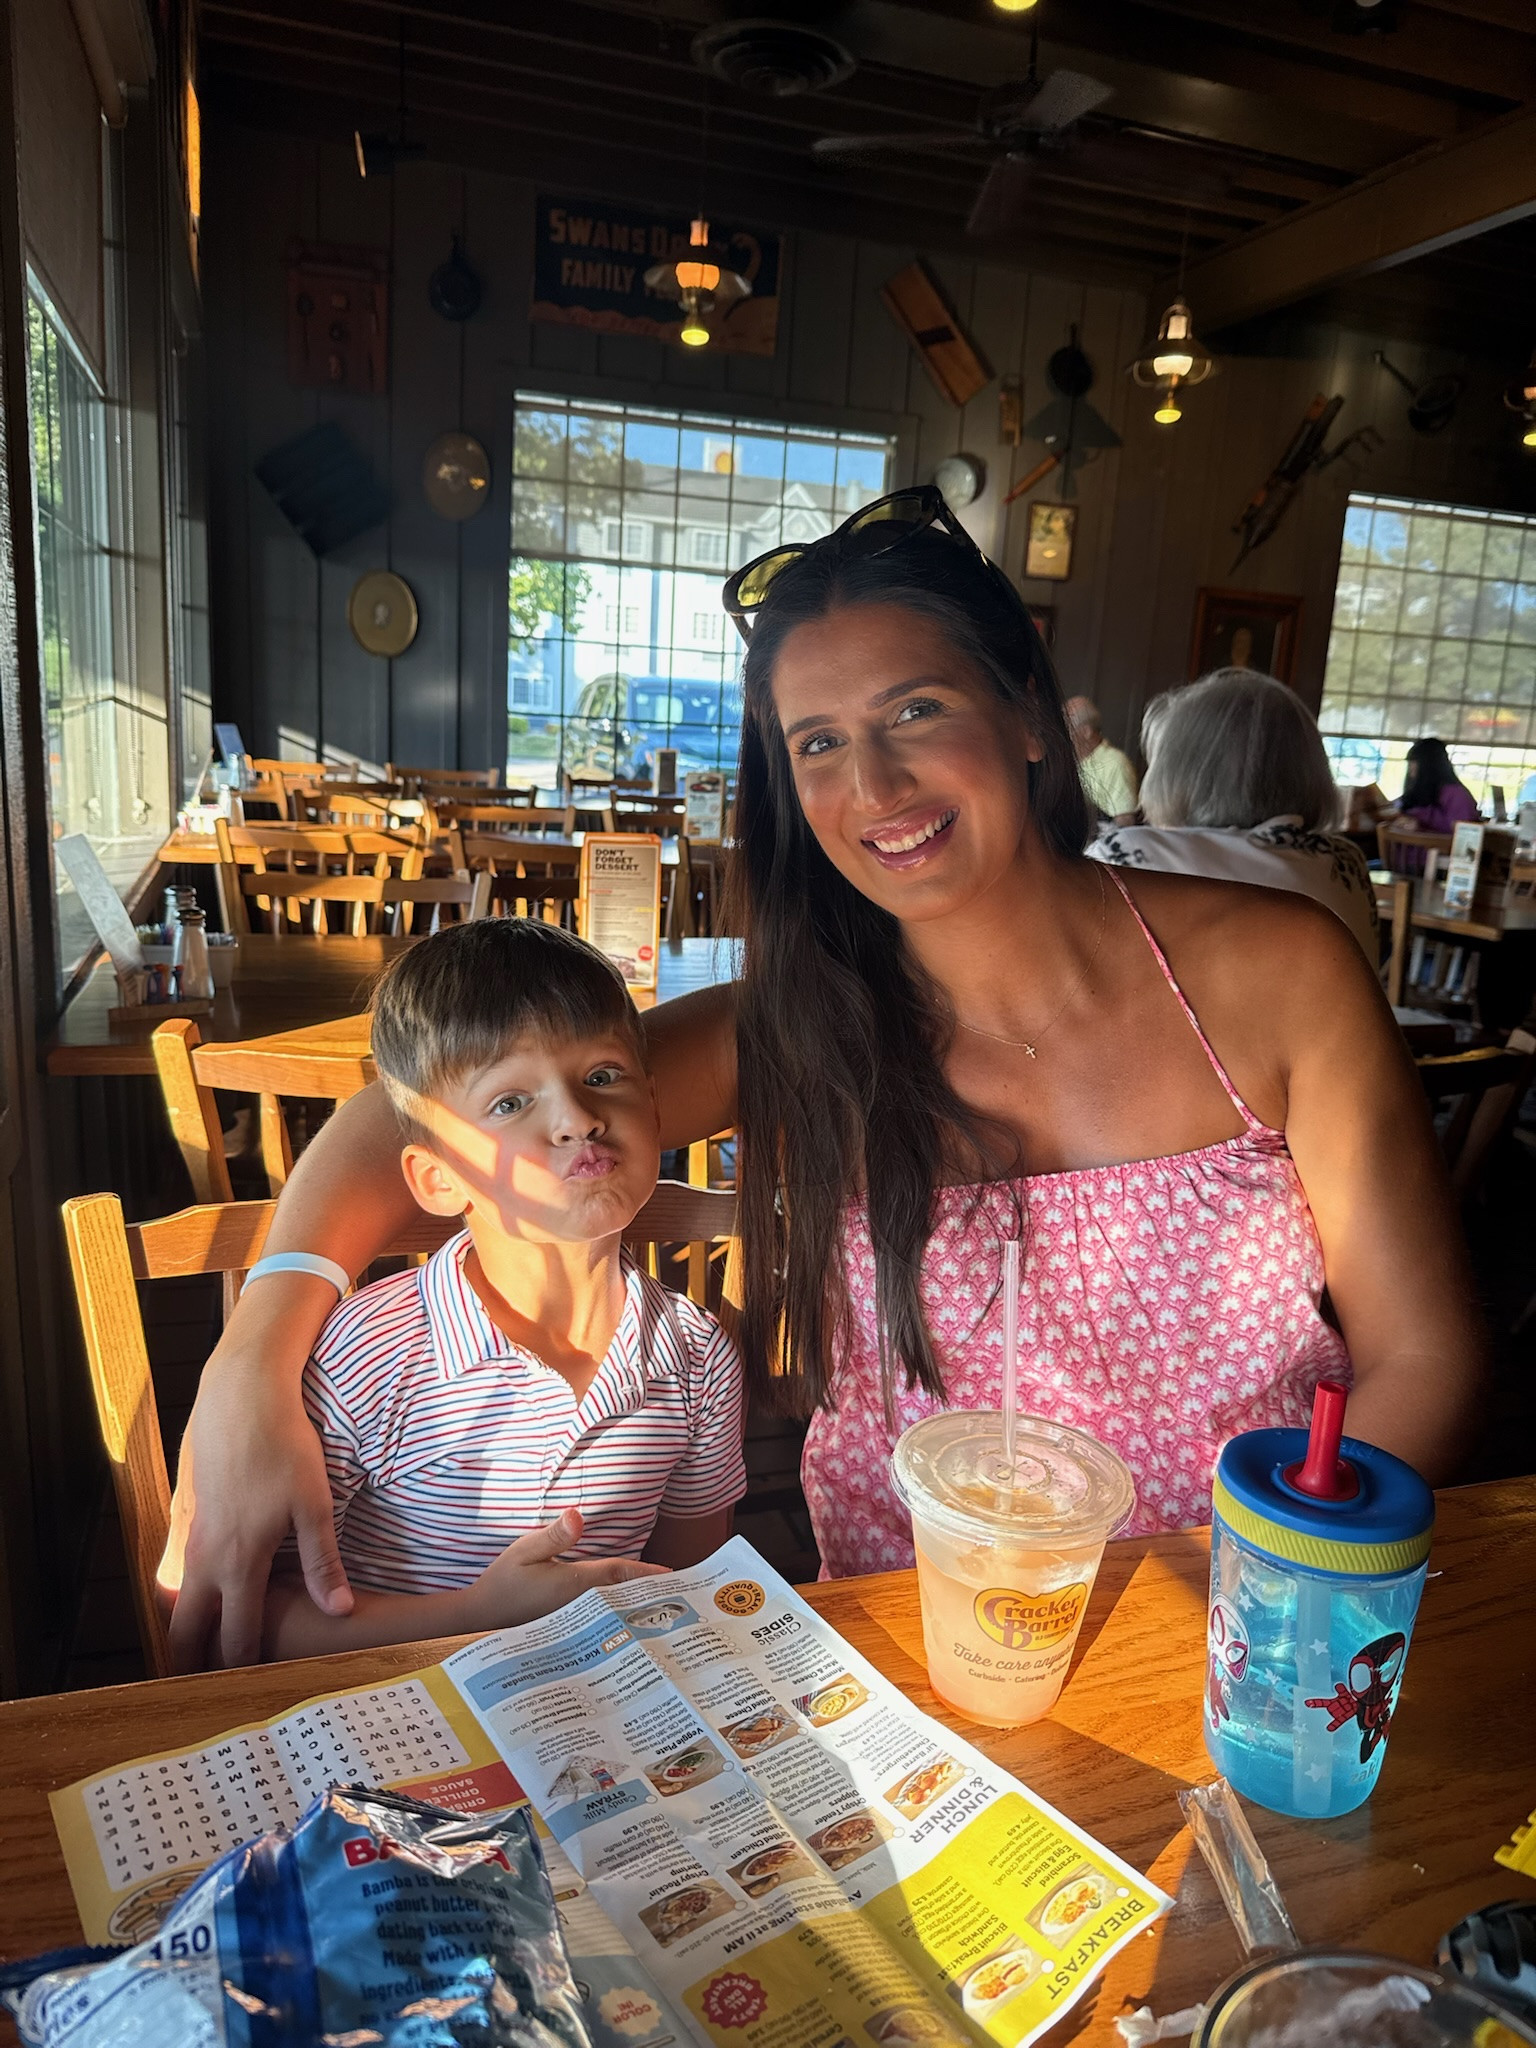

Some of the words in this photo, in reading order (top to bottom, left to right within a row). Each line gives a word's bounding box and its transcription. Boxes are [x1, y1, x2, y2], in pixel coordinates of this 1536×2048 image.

[548, 208, 646, 256] SWANS
[561, 258, 636, 294] FAMILY
[595, 848, 625, 856] DON'T
[595, 856, 634, 864] FORGET
[718, 1583, 752, 1599] QUALITY
[983, 1595, 1080, 1631] Cracker
[750, 1612, 793, 1640] SIDES
[757, 1619, 802, 1649] Classic
[1004, 1606, 1078, 1650] Barrel
[602, 1630, 630, 1651] NEW
[671, 1636, 696, 1648] Potatoes
[686, 1641, 705, 1652] Cheese
[710, 1636, 721, 1644] Mac
[711, 1643, 727, 1652] Green
[576, 1648, 600, 1662] Kid's
[695, 1648, 711, 1658] Beans
[703, 1655, 717, 1663] Fries
[717, 1649, 733, 1659] Steak
[953, 1642, 992, 1668] Take
[995, 1660, 1032, 1671] care
[534, 1662, 564, 1678] Cream
[563, 1658, 578, 1668] Ice
[614, 1652, 646, 1675] Hashbrown
[637, 1659, 652, 1671] Corn
[816, 1666, 823, 1674] &
[822, 1658, 838, 1670] Mac
[500, 1672, 534, 1689] Sundae
[586, 1671, 615, 1688] Casserole
[629, 1667, 657, 1686] Seasoned
[635, 1673, 663, 1692] Dumplins
[792, 1669, 817, 1686] Cheese
[818, 1664, 844, 1683] Mmmm
[968, 1668, 1006, 1682] Curbside
[616, 1682, 630, 1693] Rice
[553, 1695, 576, 1707] Carrots
[734, 1687, 769, 1708] Sandwich
[751, 1694, 775, 1710] Grilled
[530, 1712, 555, 1724] Broccoli
[555, 1703, 581, 1716] Steamed
[724, 1705, 752, 1722] Cheese
[675, 1725, 703, 1745] Veggie
[654, 1741, 676, 1756] Plate
[923, 1741, 936, 1753] Lil'
[810, 1757, 829, 1769] Served
[901, 1750, 925, 1770] Barrel
[786, 1770, 799, 1780] your
[799, 1765, 811, 1775] with
[428, 1777, 473, 1793] SAUCE
[770, 1777, 788, 1789] choice
[968, 1775, 985, 1791] &
[585, 1788, 625, 1811] STRAW
[604, 1791, 636, 1812] Candy
[827, 1787, 858, 1808] Dippers
[839, 1794, 866, 1812] Crispy
[583, 1806, 605, 1821] Milk
[813, 1808, 841, 1826] Tender
[908, 1786, 972, 1844] DINNER
[939, 1782, 997, 1834] LUNCH
[649, 1834, 661, 1844] and
[661, 1828, 674, 1839] side
[750, 1821, 782, 1839] Tenders
[614, 1841, 645, 1859] buttermilk
[730, 1838, 764, 1860] Chicken
[1053, 1842, 1071, 1860] Egg
[594, 1854, 615, 1867] biscuit
[669, 1860, 701, 1877] Shrimp
[1038, 1851, 1081, 1887] Scrambled
[1046, 1856, 1056, 1866] &
[678, 1866, 708, 1885] Crispy
[1020, 1863, 1049, 1888] Biscuit
[362, 1874, 412, 1898] Bamba
[416, 1874, 431, 1890] is
[647, 1879, 679, 1900] Rockin'
[374, 1896, 429, 1917] peanut
[431, 1896, 479, 1912] butter
[815, 1889, 863, 1910] Available
[765, 1900, 815, 1930] starting
[376, 1920, 426, 1940] dating
[428, 1918, 464, 1936] back
[466, 1920, 483, 1934] to
[755, 1923, 769, 1936] at
[958, 1914, 998, 1948] Sandwich
[976, 1921, 1007, 1949] Biscuit
[149, 1924, 210, 1960] 150
[721, 1935, 746, 1954] AM
[1042, 1896, 1144, 1999] BREAKFAST
[382, 1946, 422, 1968] Made
[427, 1943, 465, 1963] with
[937, 1944, 979, 1980] Breakfast
[709, 1978, 753, 2015] BREAKFAST
[723, 1988, 741, 2004] DAY
[727, 1994, 746, 2010] ALL
[612, 2003, 652, 2024] COLOR
[730, 1997, 760, 2022] TASTY
